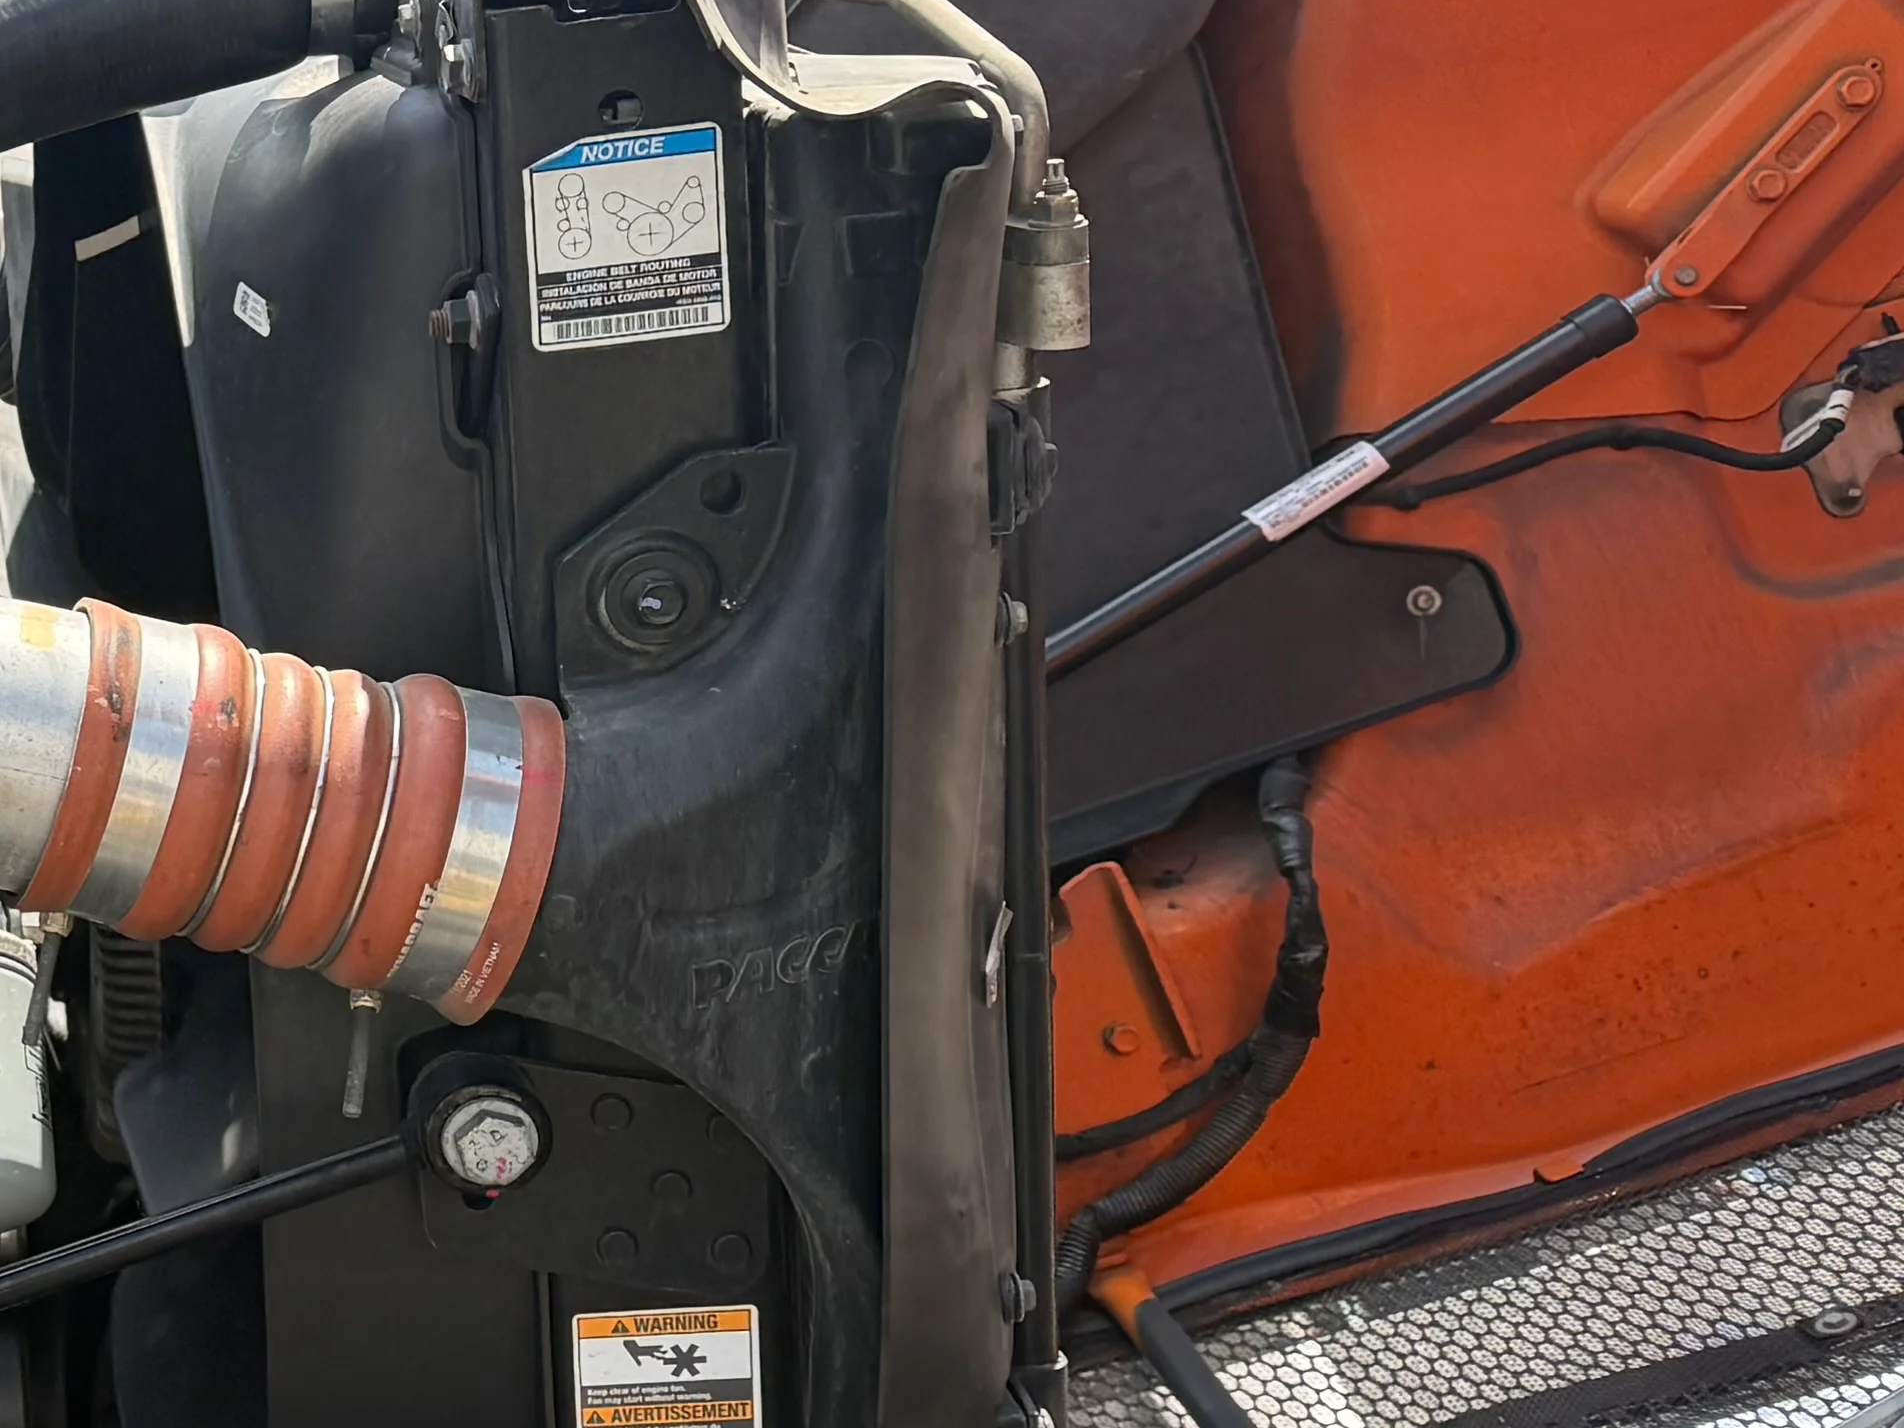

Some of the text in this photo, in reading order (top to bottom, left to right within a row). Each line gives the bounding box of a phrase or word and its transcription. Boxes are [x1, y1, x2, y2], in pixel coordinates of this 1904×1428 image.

[581, 138, 664, 164] NOTICE
[610, 265, 637, 277] BELT
[692, 922, 855, 1009] PACC
[634, 1314, 718, 1332] WARNING
[611, 1403, 748, 1423] AVERTISSEMENT
